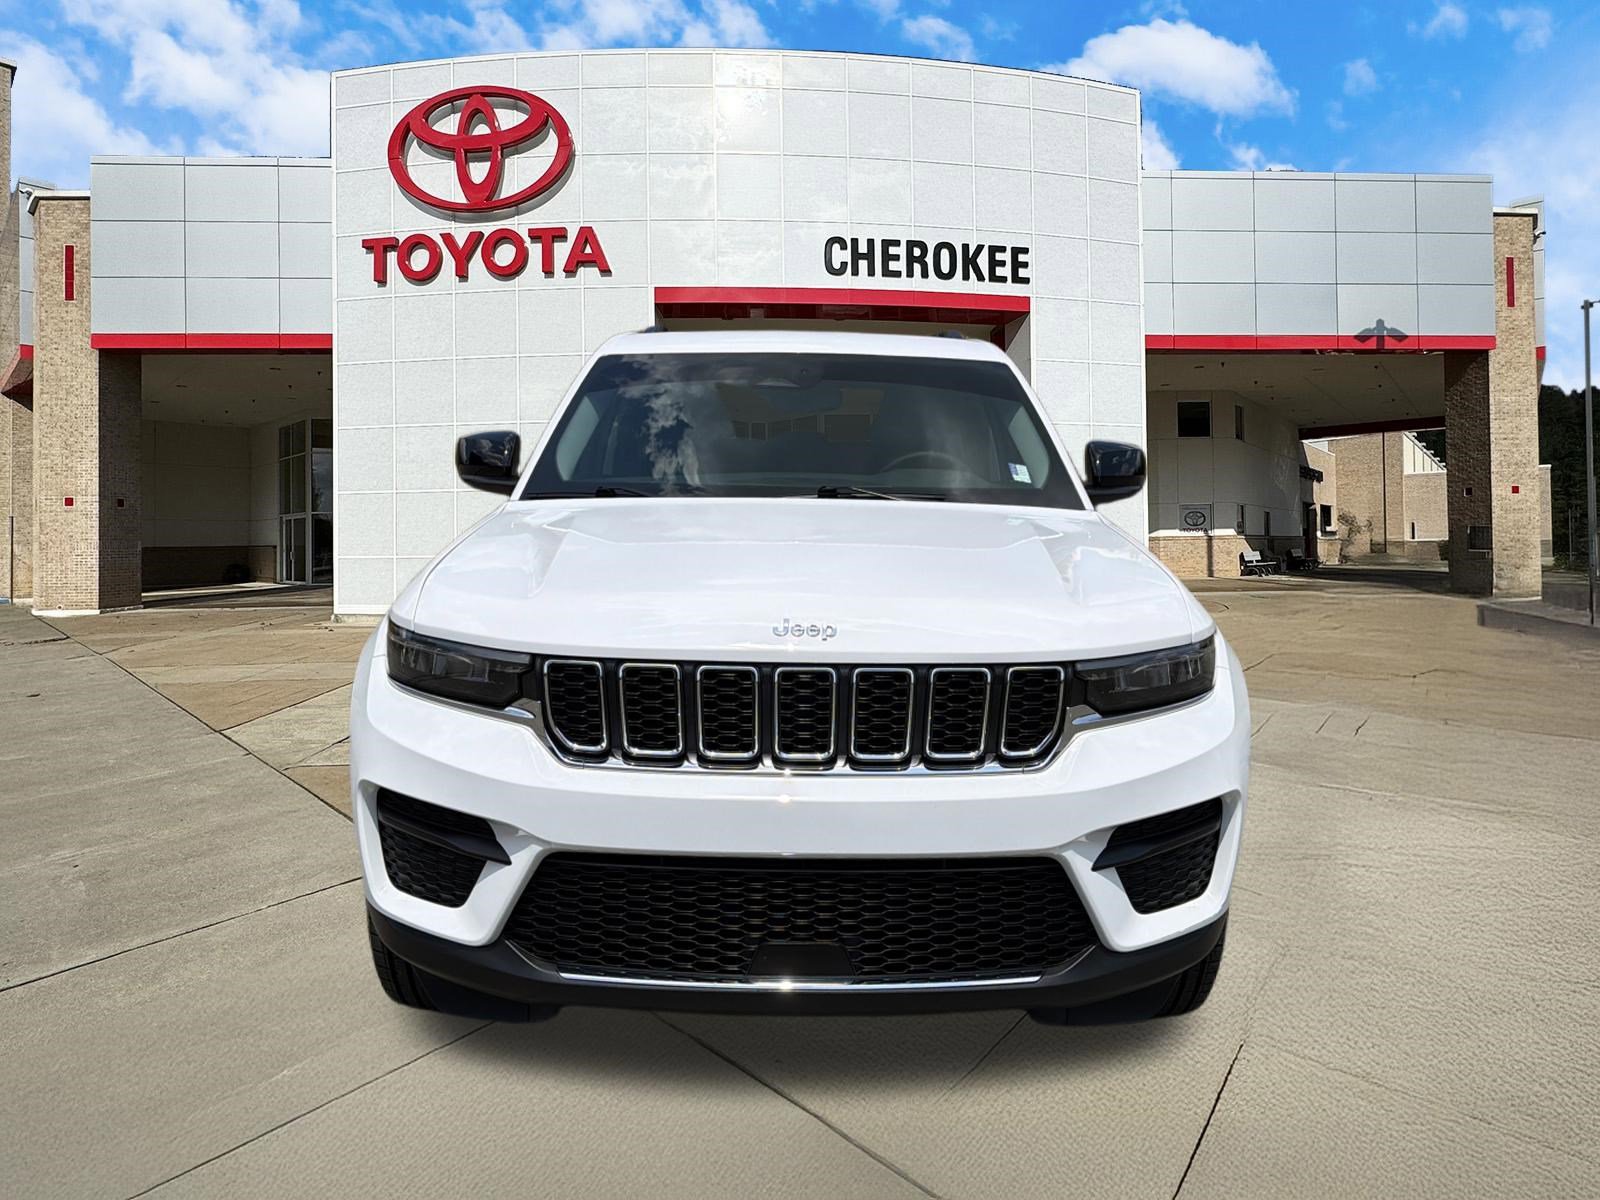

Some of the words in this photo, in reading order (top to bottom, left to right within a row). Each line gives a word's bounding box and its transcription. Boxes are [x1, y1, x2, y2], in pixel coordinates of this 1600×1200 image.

[362, 226, 612, 285] TOYOTA
[824, 236, 1031, 285] CHEROKEE
[772, 618, 837, 641] Jeep
